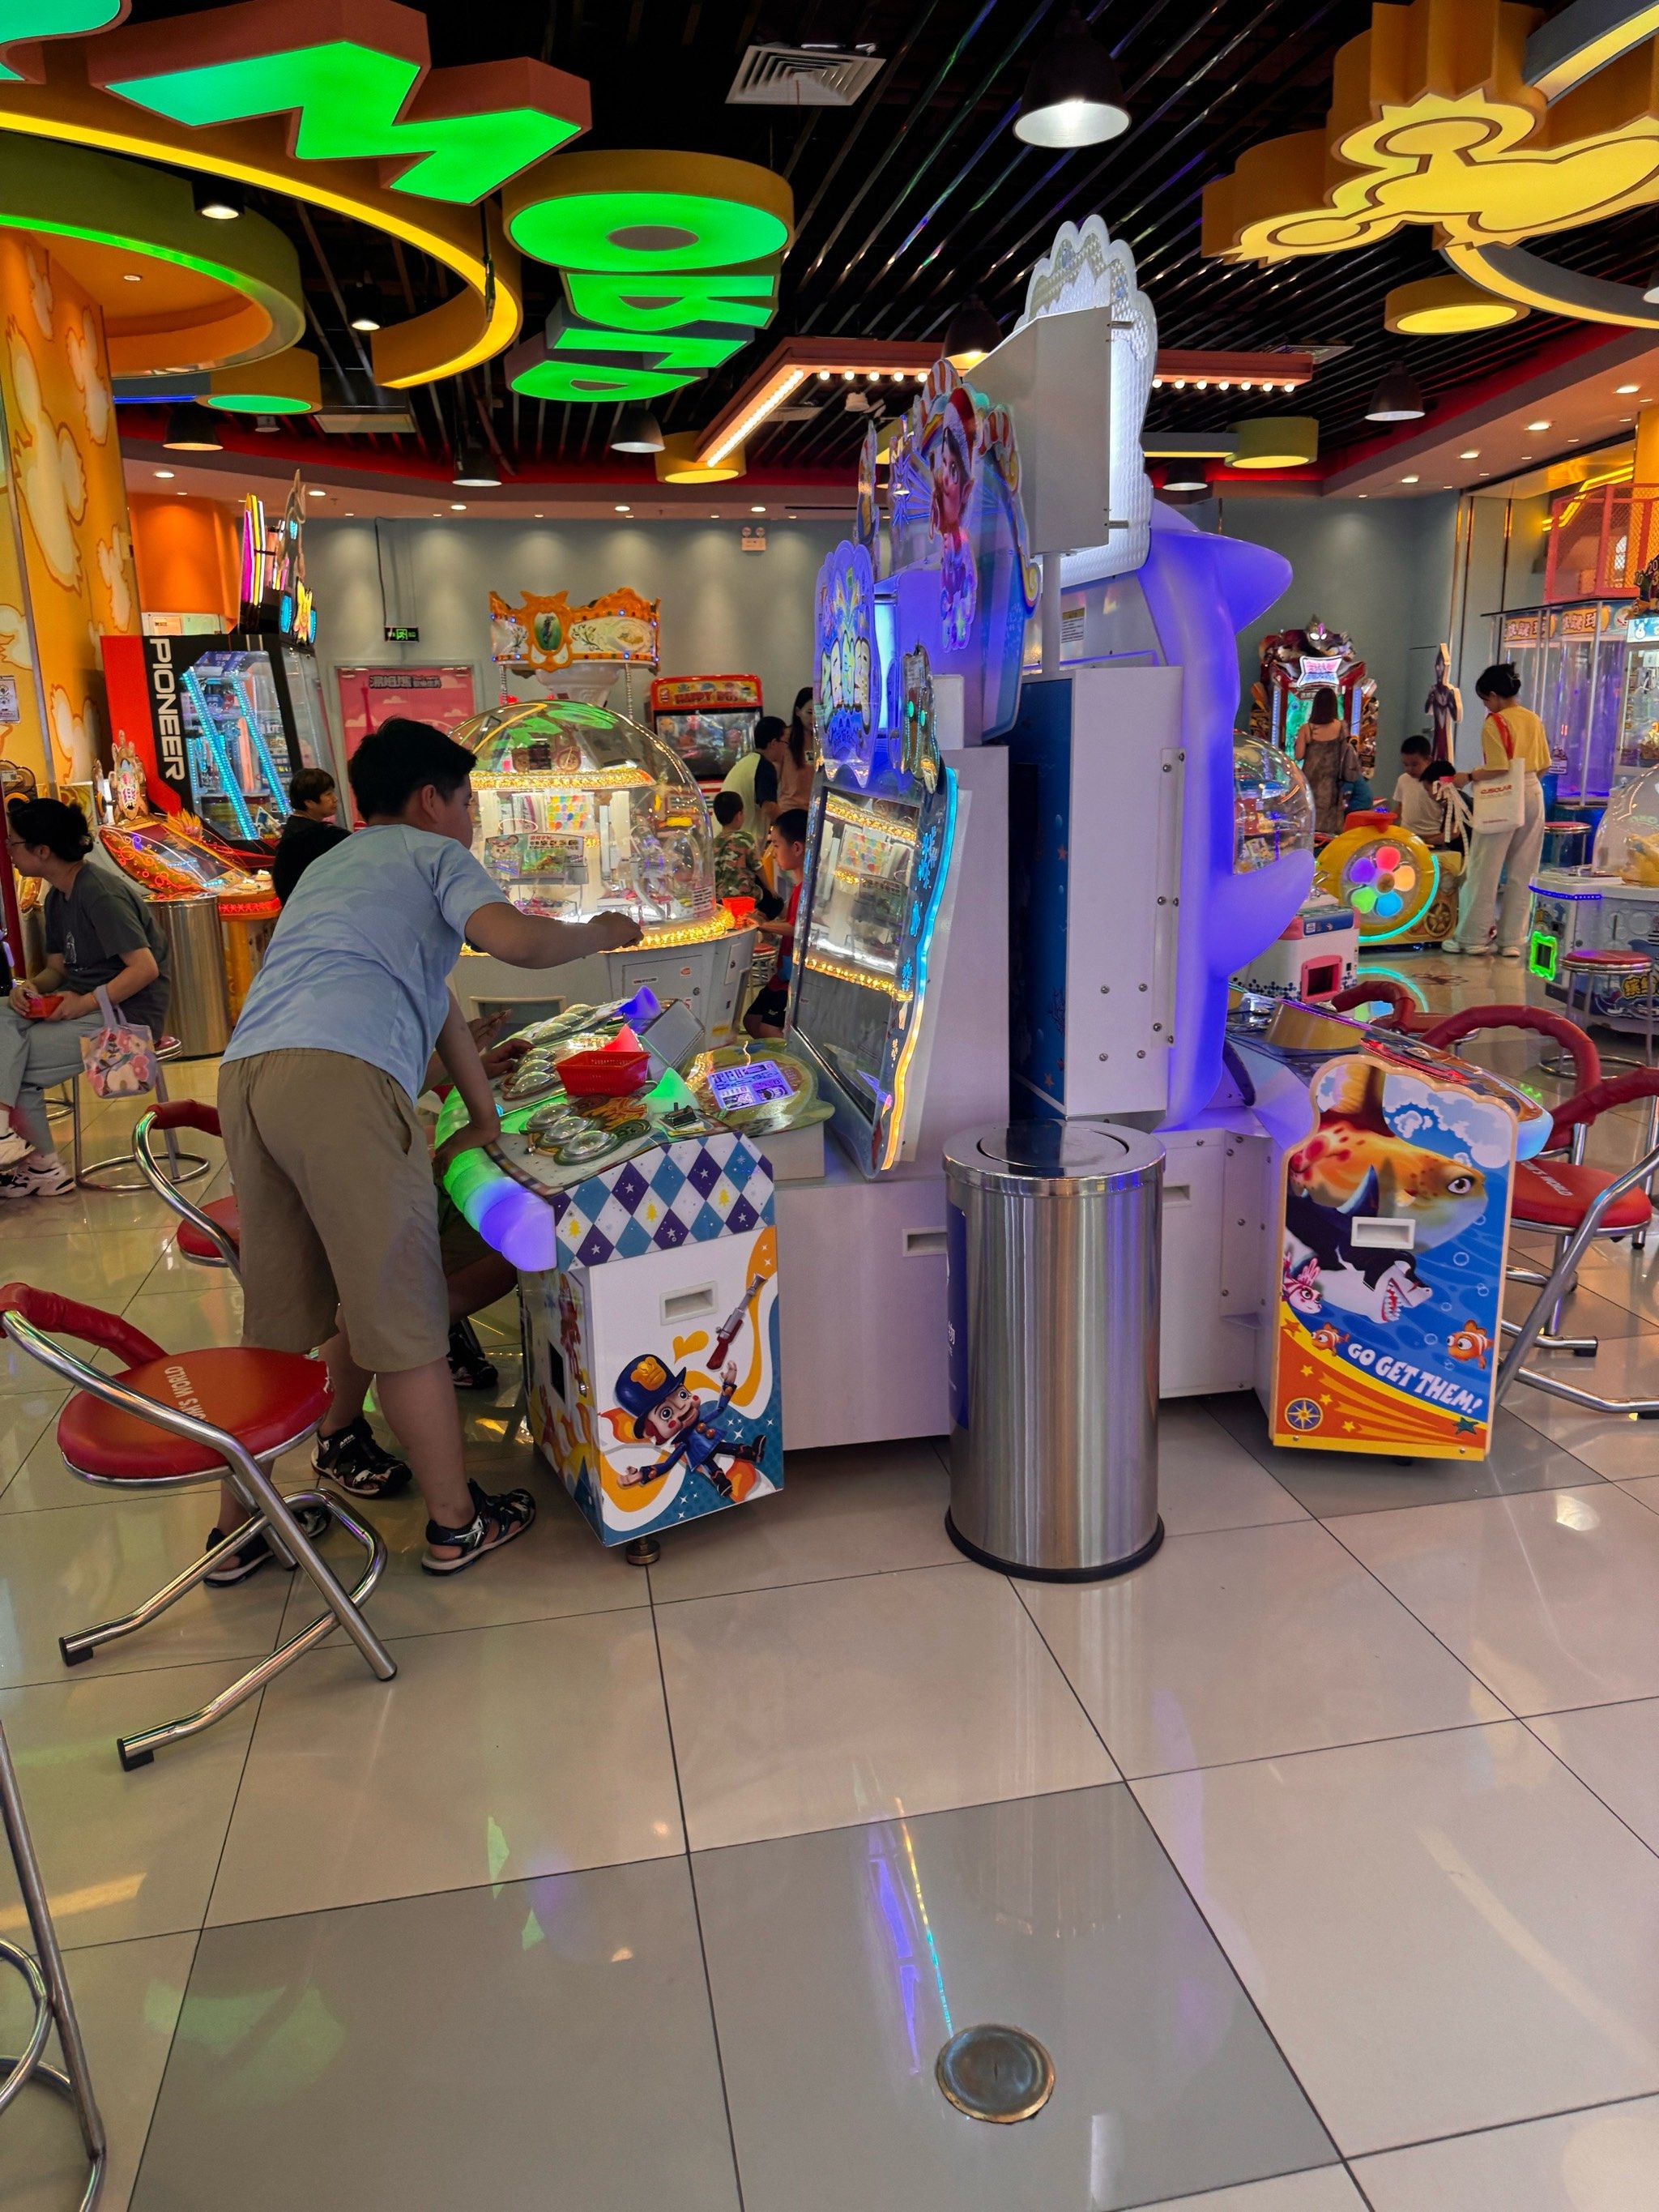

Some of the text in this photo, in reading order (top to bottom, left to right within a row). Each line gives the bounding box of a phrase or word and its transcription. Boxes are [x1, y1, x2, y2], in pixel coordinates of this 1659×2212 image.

[103, 40, 791, 403] WORLD
[149, 638, 186, 781] PIONEER
[164, 1366, 194, 1398] WORLD
[1347, 1343, 1483, 1414] GO GET THEM!
